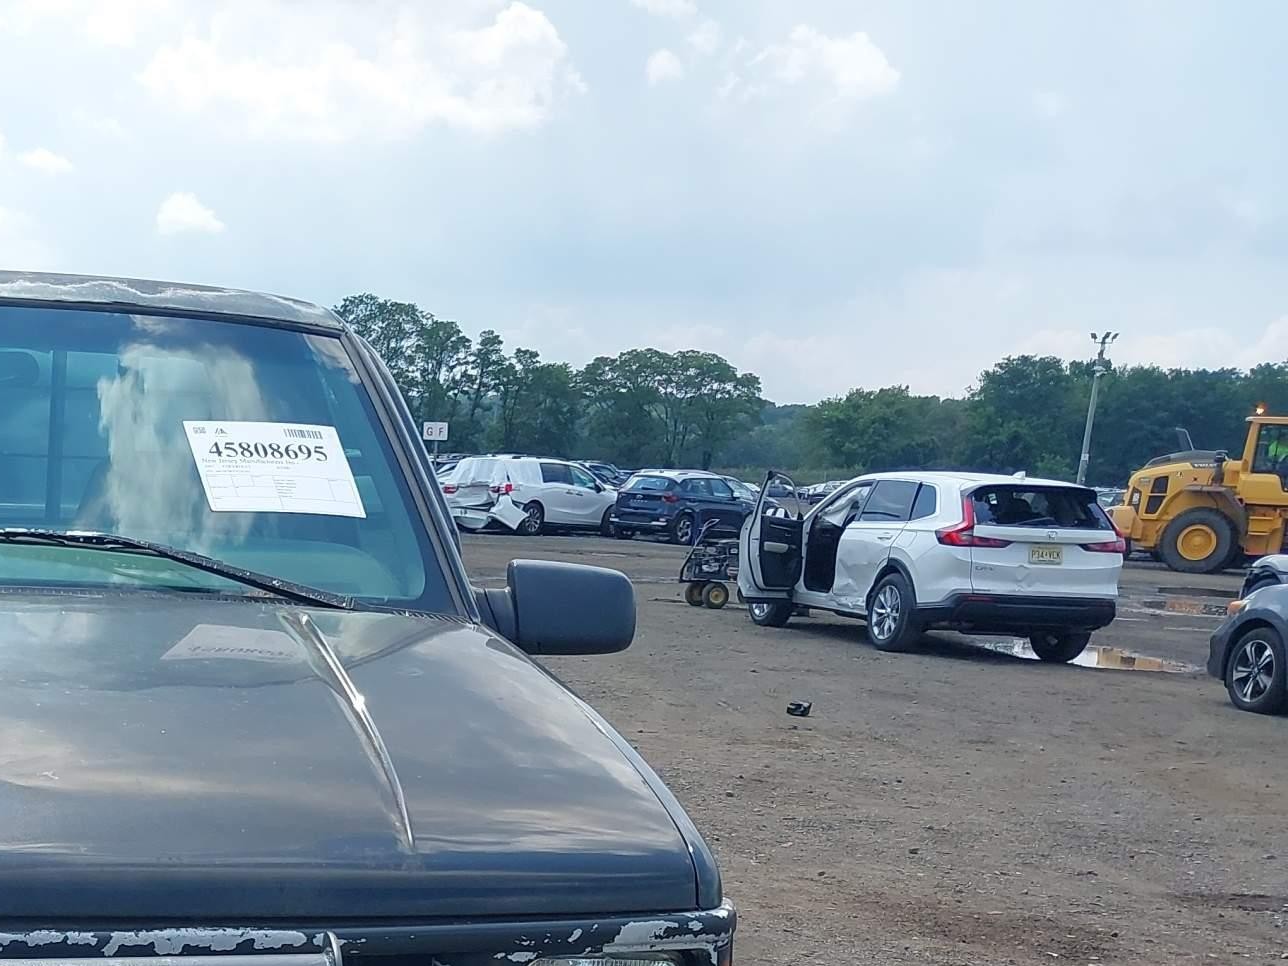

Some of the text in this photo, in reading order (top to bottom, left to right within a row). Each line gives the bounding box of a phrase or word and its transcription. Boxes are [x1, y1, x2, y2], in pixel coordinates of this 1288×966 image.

[426, 426, 444, 437] G F
[208, 441, 328, 462] 45808695
